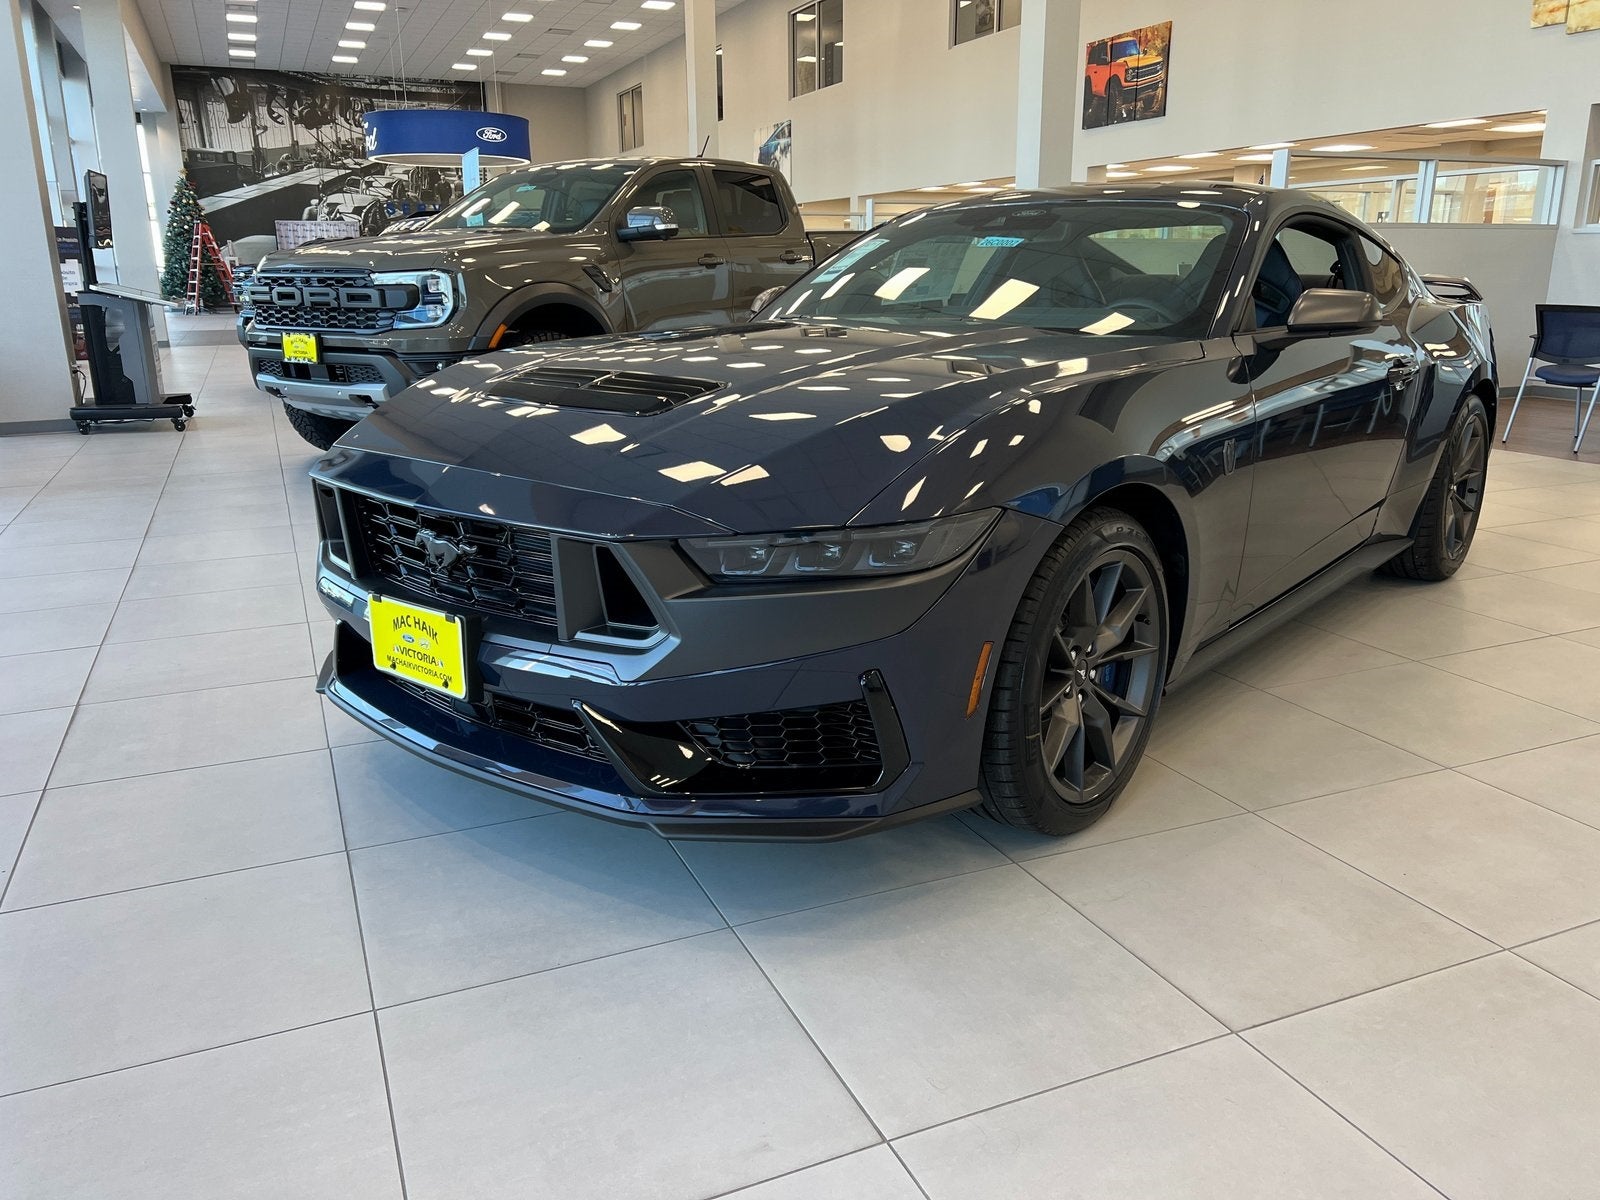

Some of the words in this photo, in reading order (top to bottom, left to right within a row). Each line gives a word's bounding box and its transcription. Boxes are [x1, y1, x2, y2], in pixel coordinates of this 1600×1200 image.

[481, 128, 503, 140] Ford
[250, 285, 381, 309] FORD
[393, 615, 412, 632] MAC
[413, 616, 439, 645] HAIK
[398, 645, 437, 666] VICTORIA
[386, 654, 452, 683] MACHAIKVICTORIA.COM
